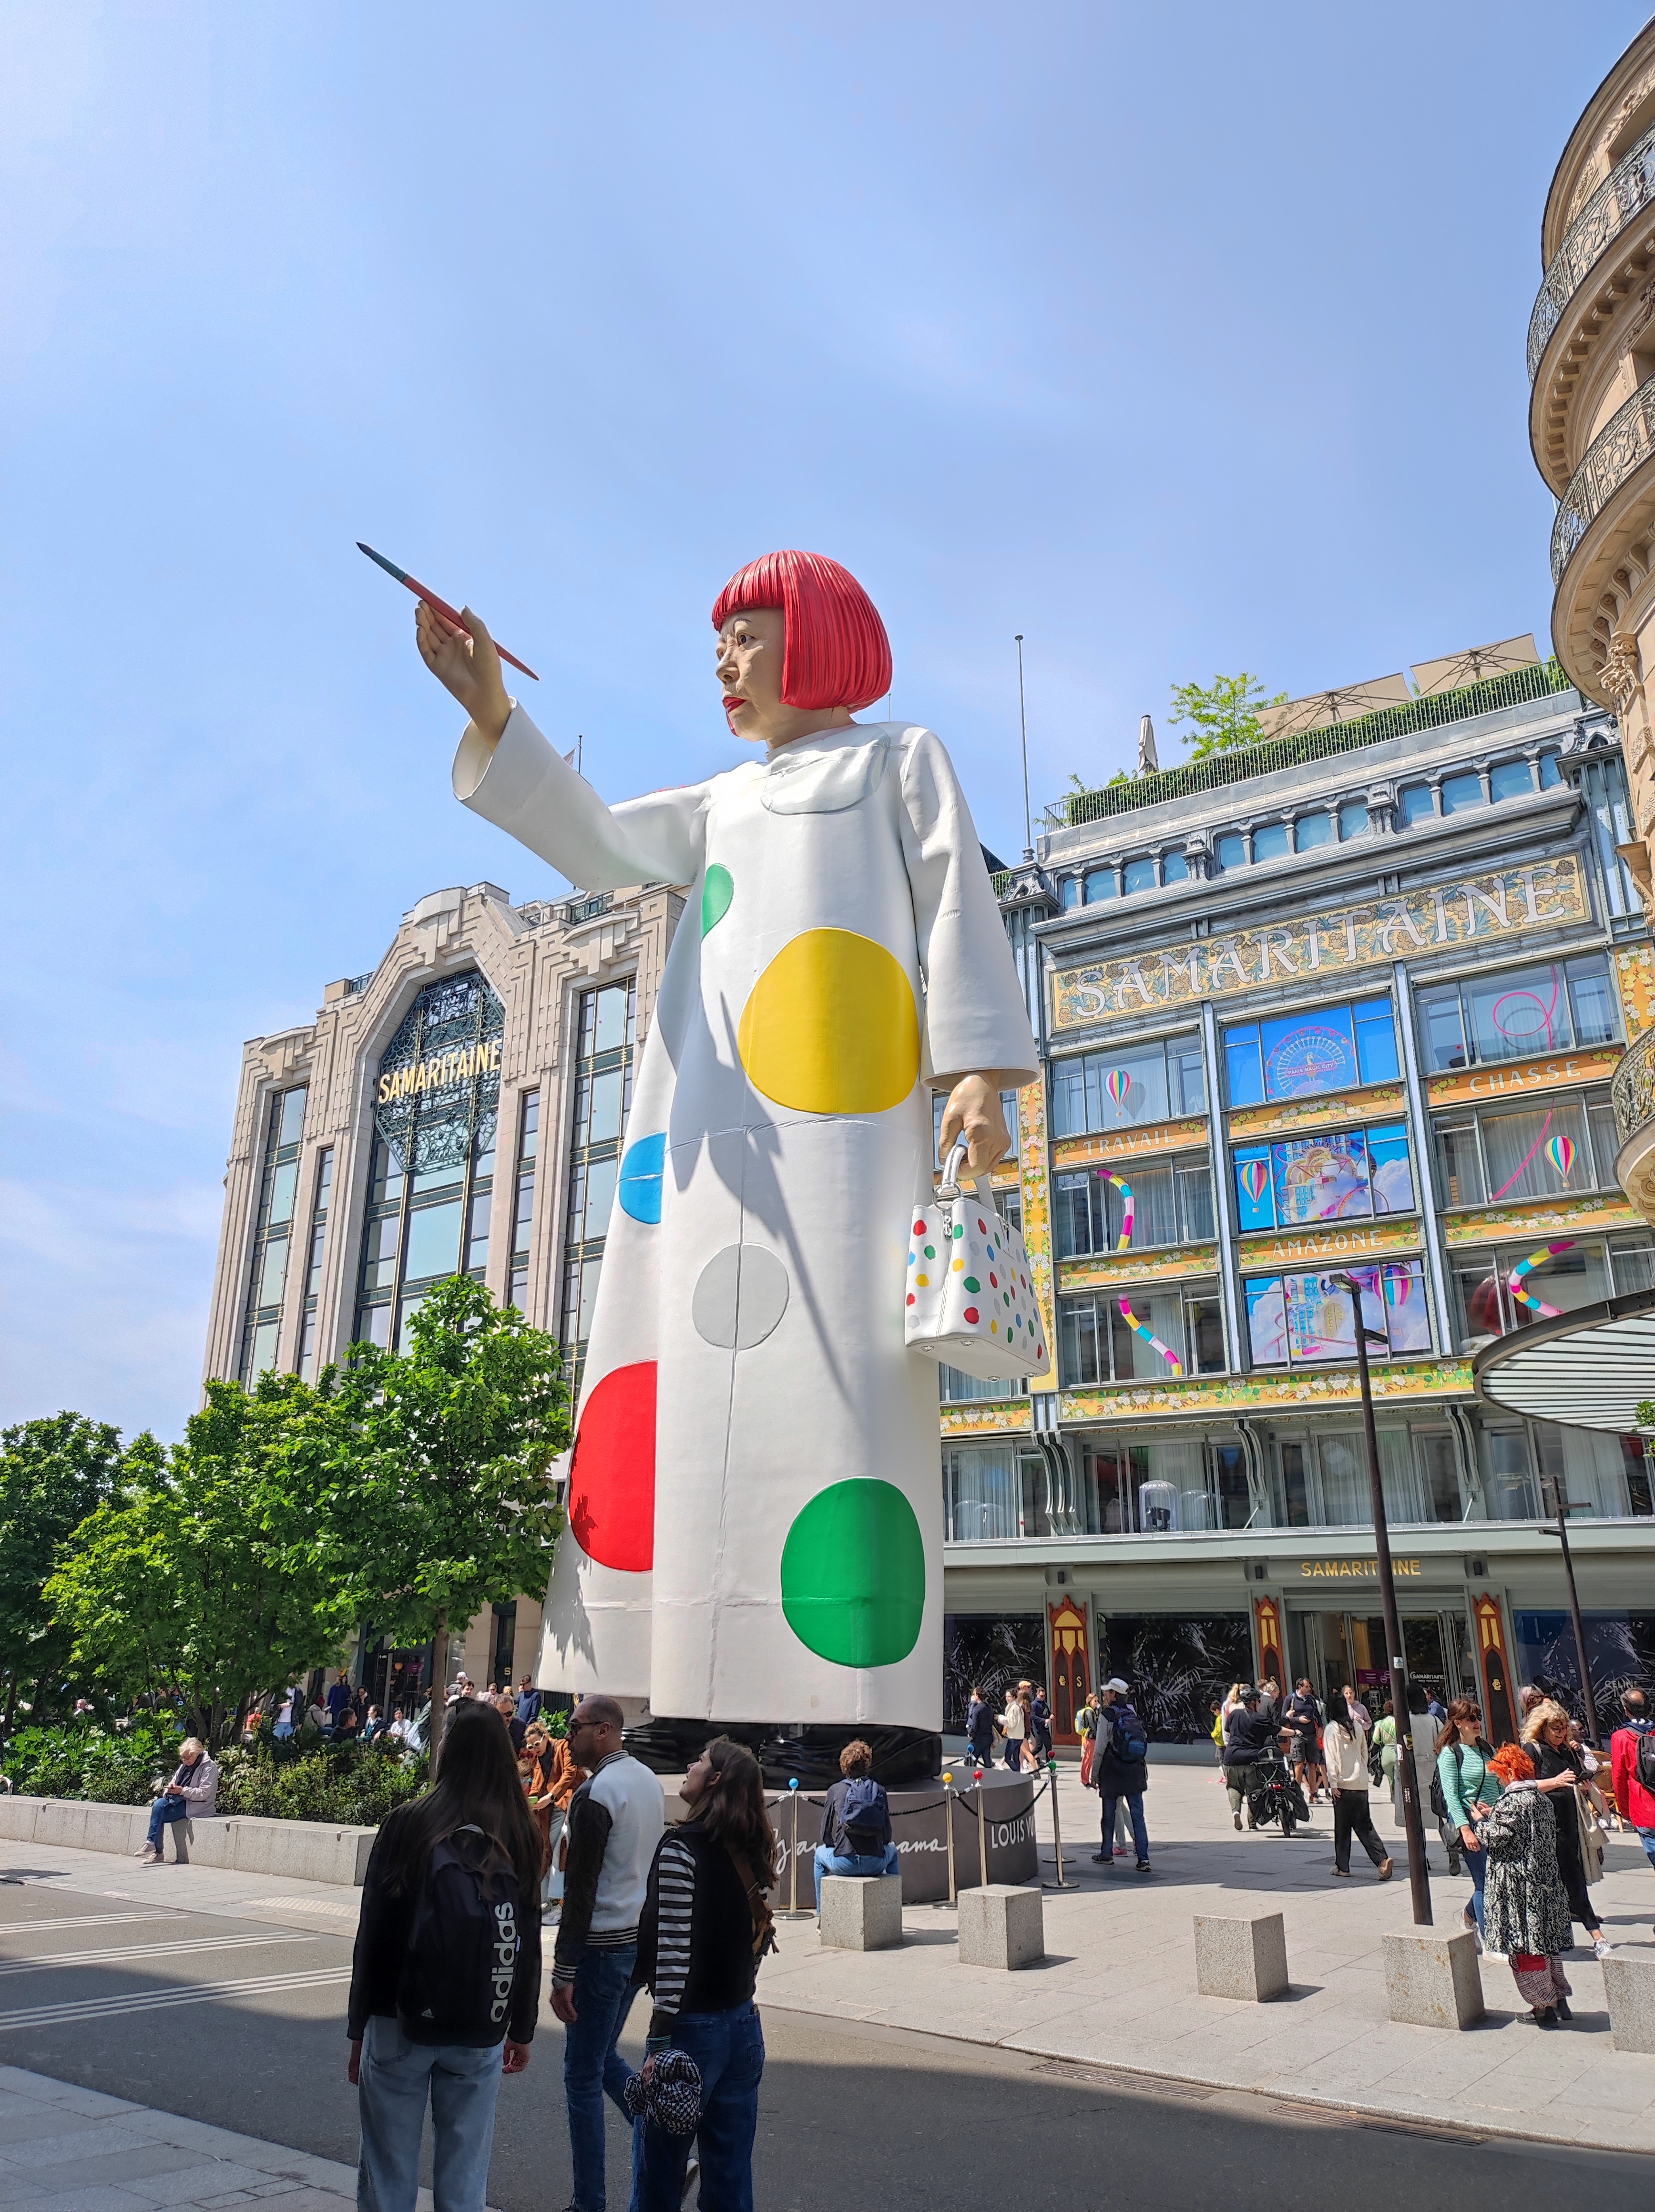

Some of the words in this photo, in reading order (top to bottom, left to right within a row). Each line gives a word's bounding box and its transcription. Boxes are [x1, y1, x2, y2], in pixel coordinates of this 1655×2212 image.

[1075, 867, 1566, 1018] SAMARITAINE
[378, 1038, 502, 1103] SAMARITAINE
[1469, 1060, 1581, 1093] CHASSE
[1083, 1129, 1176, 1156] TRAVAIL
[1272, 1229, 1383, 1258] AMAZONE
[1301, 1560, 1421, 1577] SAMARITINE
[504, 1667, 511, 1675] S
[1076, 1676, 1082, 1687] S
[991, 1819, 1025, 1849] LOUIS
[490, 1901, 516, 2023] adidas
